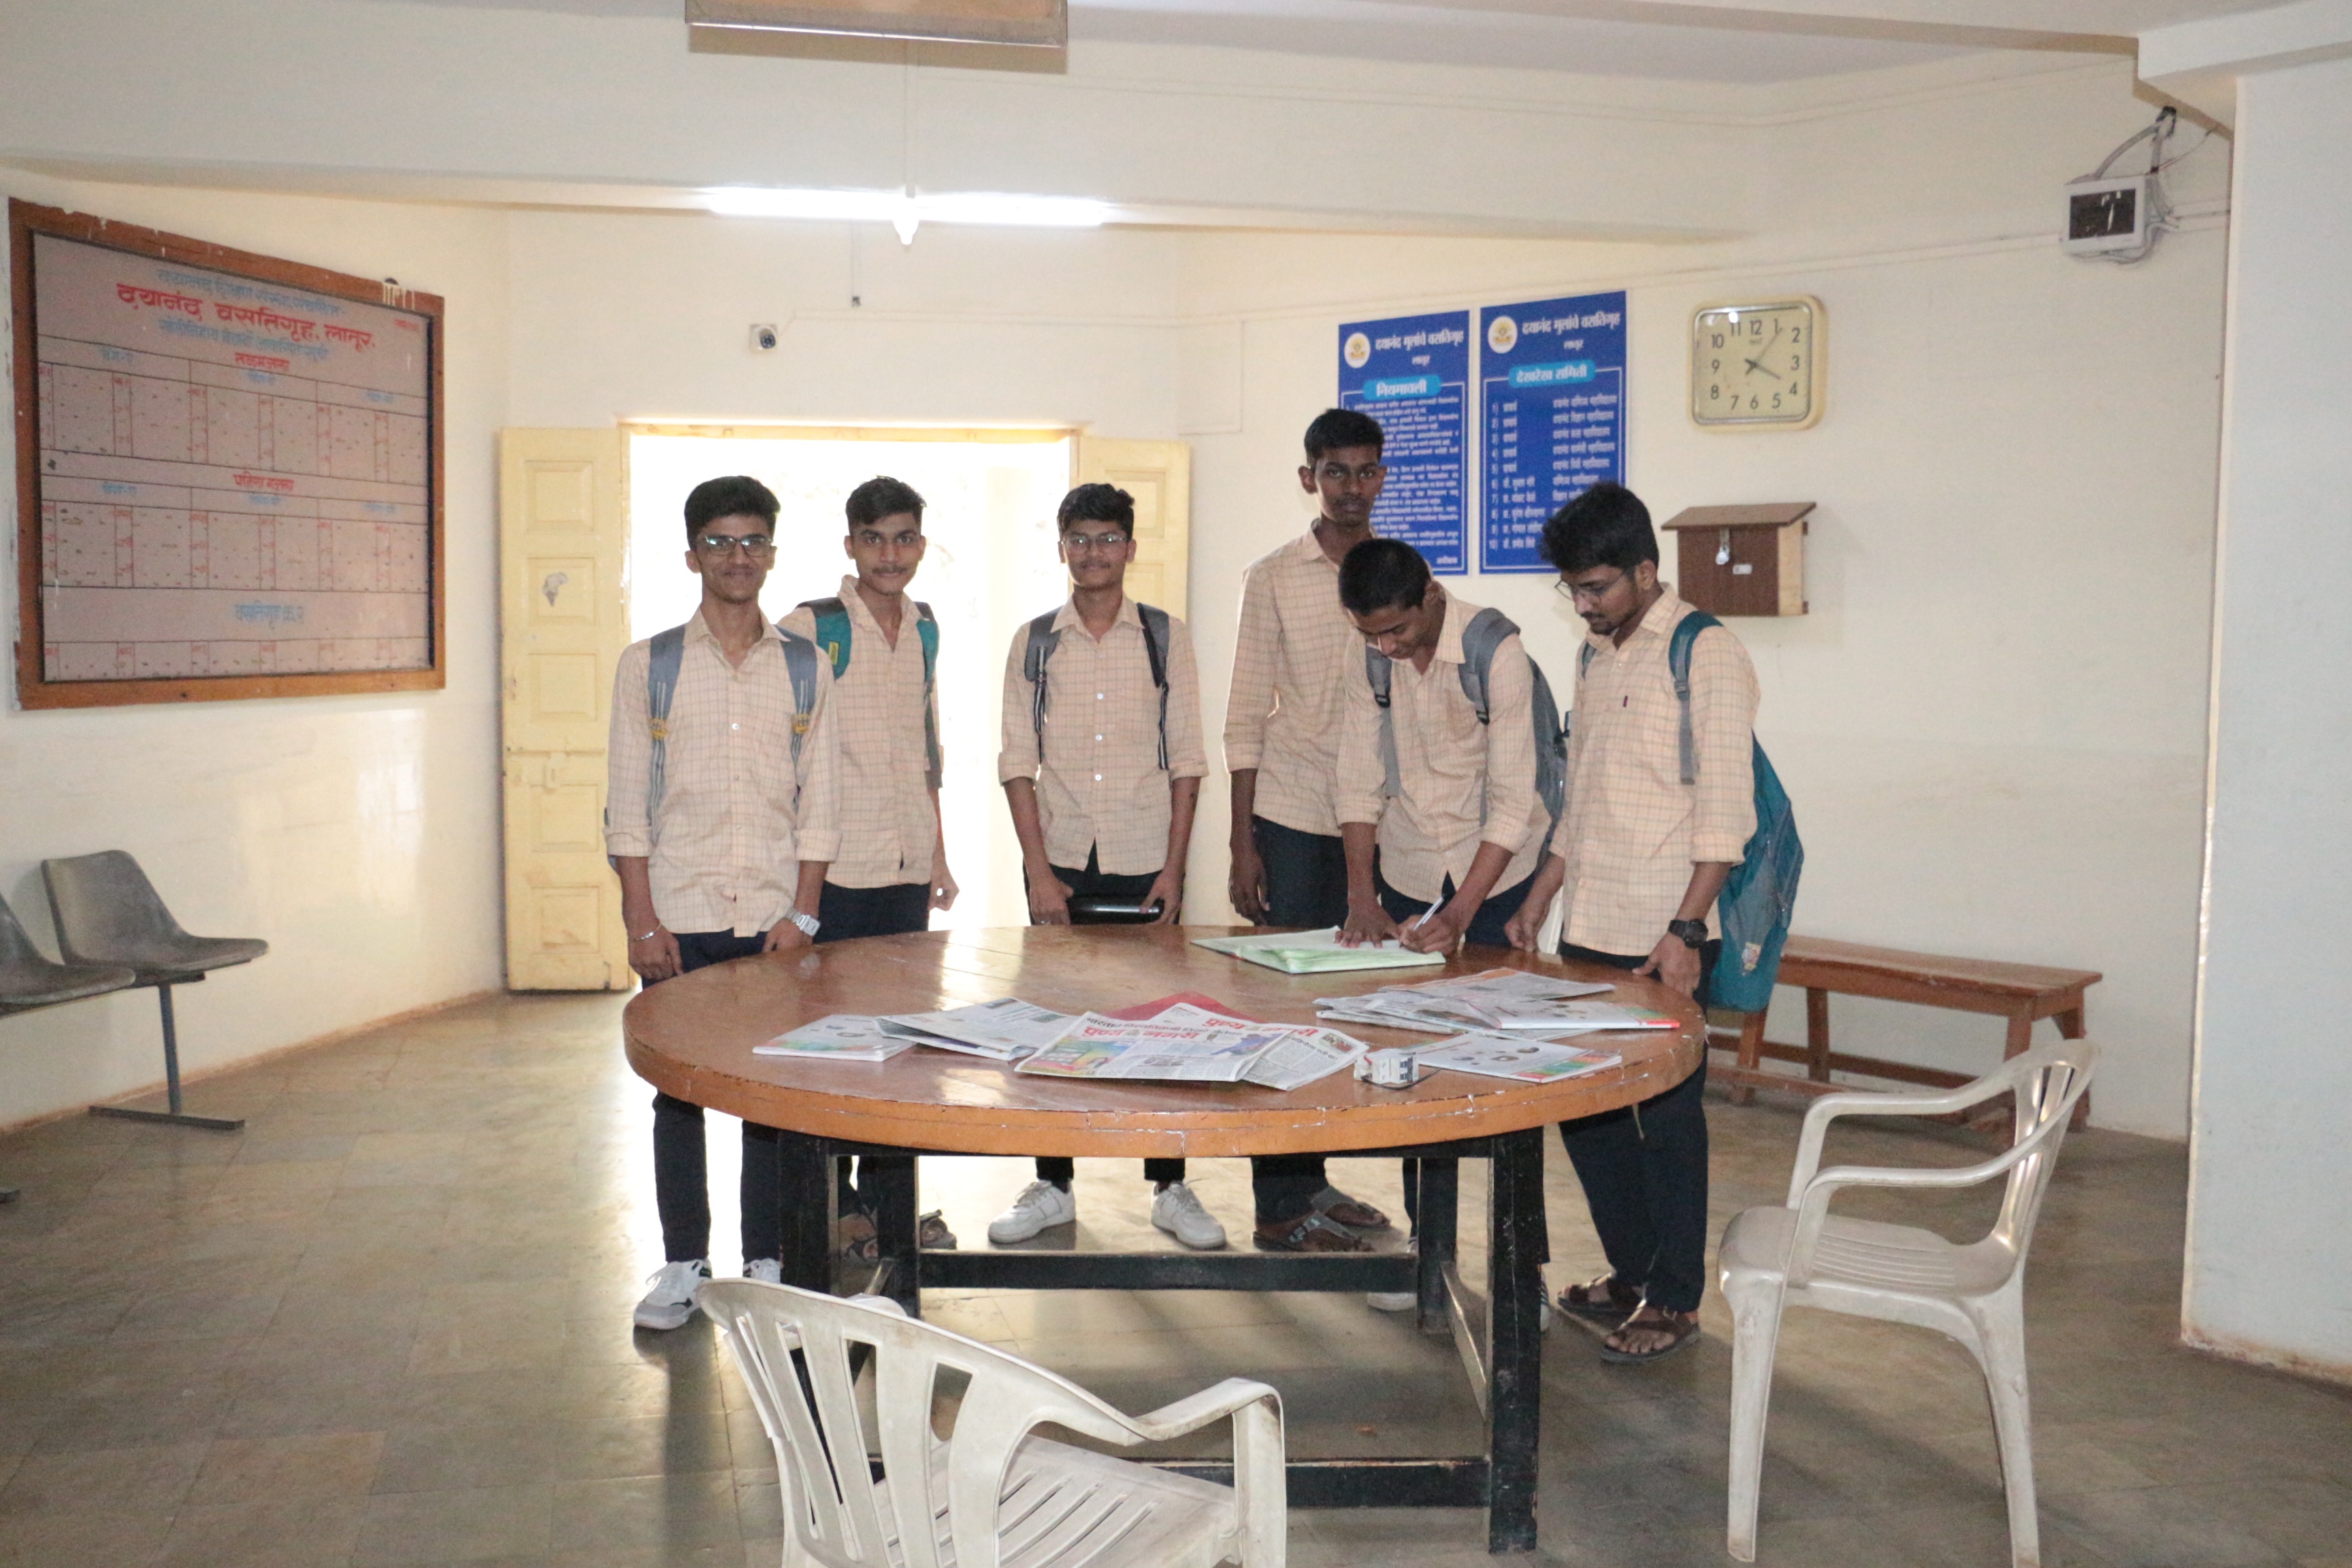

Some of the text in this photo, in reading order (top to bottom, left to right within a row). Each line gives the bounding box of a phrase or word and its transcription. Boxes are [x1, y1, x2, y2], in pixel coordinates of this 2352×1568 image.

[116, 283, 203, 322] दयानंद
[1522, 310, 1620, 336] दयानंद मुलांचे वसतिगृह
[1750, 321, 1762, 336] 12
[1375, 328, 1465, 352] दयानंद मुलांचे वसतिगृह
[1712, 333, 1724, 348] 10
[1791, 328, 1800, 343] 2
[1712, 359, 1720, 374] 9
[1791, 355, 1800, 371] 3
[1516, 363, 1588, 384] देखरेख समिती
[1376, 378, 1428, 397] नियमावली
[1710, 386, 1719, 400] 8
[1789, 382, 1797, 396] 4
[1730, 395, 1738, 410] 7
[1750, 395, 1759, 409] 6
[1771, 394, 1781, 409] 5
